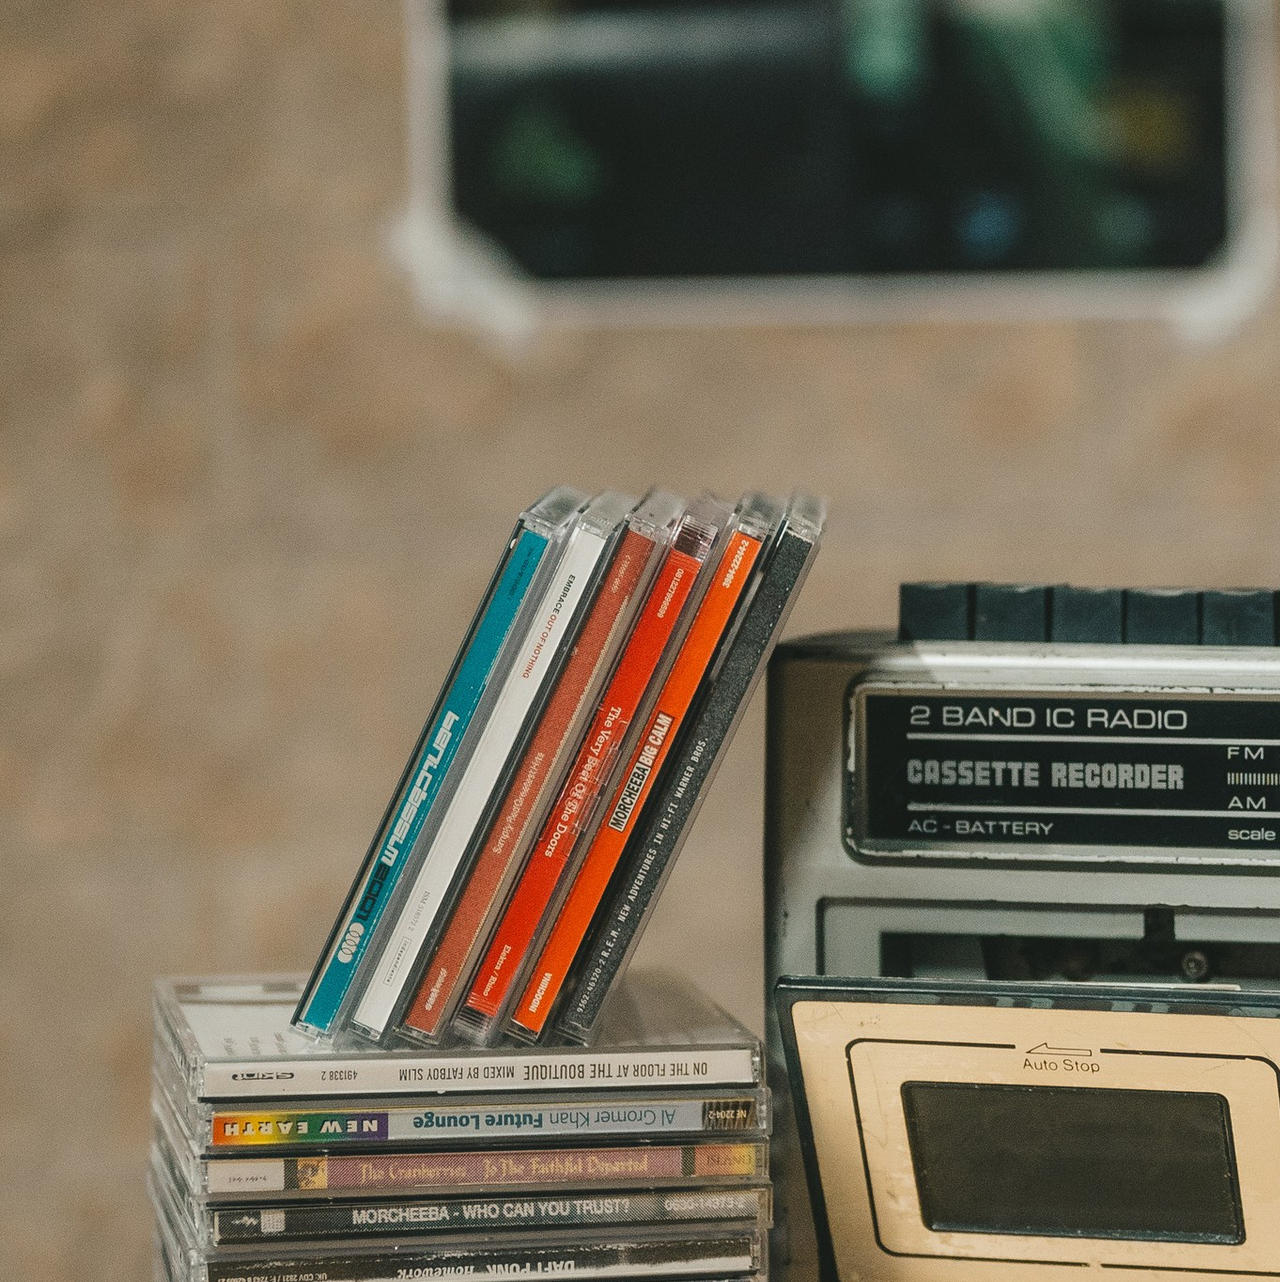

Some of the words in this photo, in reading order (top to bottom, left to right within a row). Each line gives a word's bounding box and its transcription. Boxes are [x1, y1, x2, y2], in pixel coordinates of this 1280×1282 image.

[551, 573, 576, 615] EMBRACE
[543, 613, 557, 631] OUT
[537, 630, 549, 645] OF
[521, 641, 544, 680] NOTHING
[602, 703, 622, 730] The
[911, 705, 930, 726] 2
[943, 706, 1035, 728] BAND
[1046, 708, 1075, 728] IC
[1088, 708, 1188, 730] RADIO
[646, 712, 673, 747] CALM
[587, 725, 612, 757] Very
[689, 734, 709, 763] BROS.
[638, 743, 659, 767] BIG
[1227, 746, 1265, 760] FM
[577, 754, 599, 783] Best
[906, 760, 1040, 787] CASSETTE
[1051, 763, 1184, 790] RECORDER
[569, 780, 587, 800] Of
[673, 764, 695, 799] WARNER
[609, 763, 650, 830] MORCHEEBA
[1227, 796, 1267, 809] AM
[559, 798, 579, 824] The
[658, 801, 679, 830] HI-FI
[955, 820, 1054, 836] BATTERY
[1227, 828, 1277, 841] scale
[490, 821, 515, 856] Simply
[542, 821, 568, 860] Doors
[652, 831, 665, 845] IN
[625, 846, 658, 902] ADVENTURES
[616, 902, 632, 923] NEW
[599, 924, 622, 959] R.E.M.
[493, 943, 512, 972] Elektra
[481, 974, 498, 998] Rhino
[527, 970, 553, 1013] INDOCHINA
[399, 1068, 423, 1081] SLIM
[426, 1067, 463, 1081] FATBOY
[466, 1066, 479, 1080] BY
[483, 1065, 515, 1079] MIXED
[523, 1064, 585, 1081] BOUTIQUE
[589, 1063, 613, 1079] THE
[616, 1064, 629, 1078] AT
[632, 1063, 666, 1078] FLOOR
[669, 1062, 689, 1077] THE
[693, 1062, 708, 1075] ON
[1023, 1058, 1058, 1071] Auto
[1062, 1058, 1100, 1074] Stop
[321, 1070, 327, 1081] 2
[330, 1070, 359, 1081] 491338
[413, 1111, 480, 1130] Lounge
[484, 1112, 543, 1129] Future
[550, 1111, 590, 1129] Khan
[594, 1108, 657, 1126] Gromer
[661, 1108, 677, 1126] Al
[223, 1119, 308, 1137] EARTH
[319, 1119, 378, 1134] NEW
[352, 1206, 450, 1225] MORCHEEBA
[461, 1203, 500, 1219] WHO
[502, 1201, 535, 1218] CAN
[537, 1200, 570, 1217] YOU
[571, 1198, 631, 1216] TRUST?
